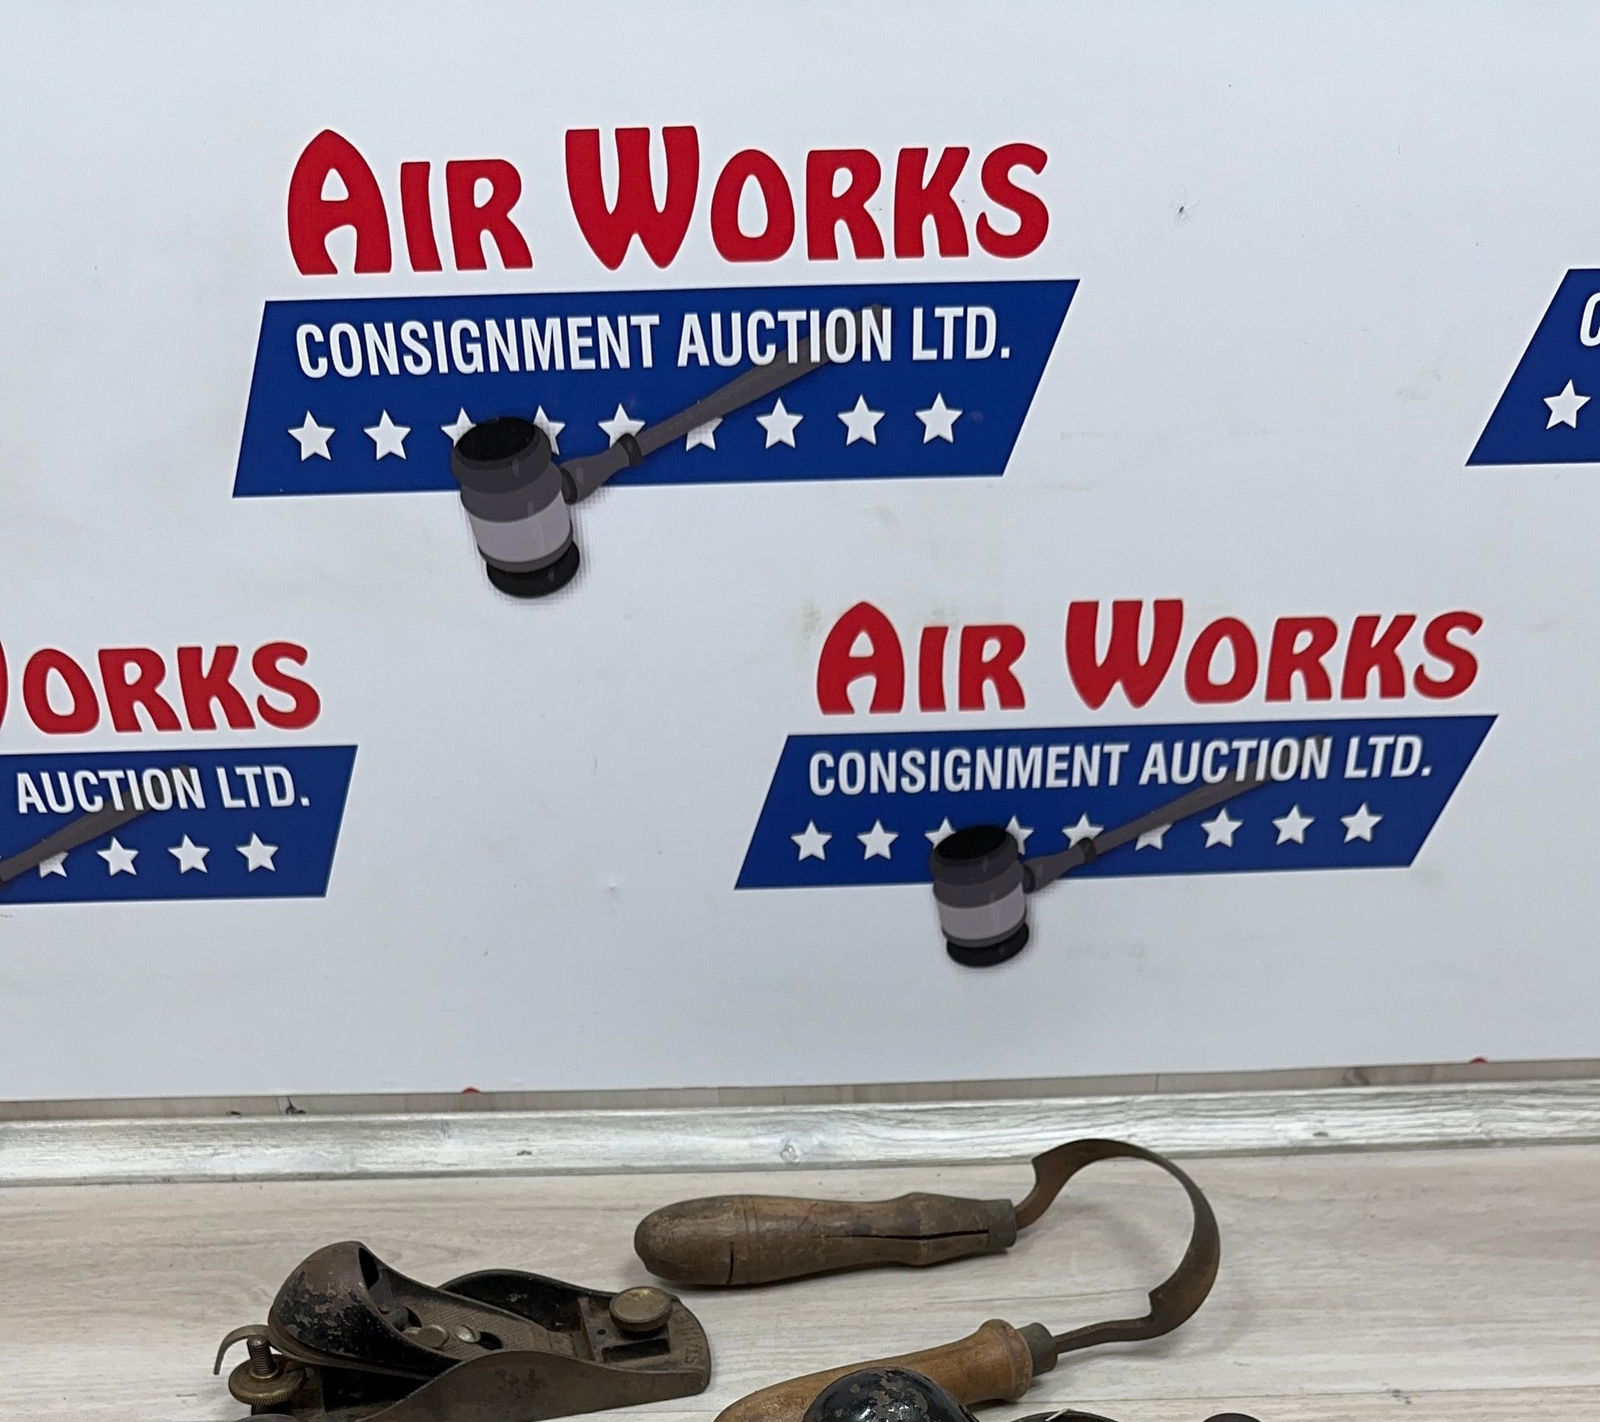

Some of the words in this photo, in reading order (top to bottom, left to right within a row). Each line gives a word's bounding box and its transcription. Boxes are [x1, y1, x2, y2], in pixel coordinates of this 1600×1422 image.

[287, 129, 533, 276] AIR
[565, 125, 1049, 270] WORKS
[296, 314, 660, 378] CONSIGNMENT
[677, 308, 892, 369] AUCTION
[912, 306, 1010, 361] LTD.
[0, 641, 321, 735] ORKS
[816, 602, 1026, 715] AIR
[1066, 599, 1483, 709] WORKS
[16, 767, 206, 814] AUCTION
[216, 766, 310, 808] LTD.
[808, 743, 1130, 796] CONSIGNMENT
[1138, 736, 1332, 785] AUCTION
[1344, 735, 1432, 778] LTD.
